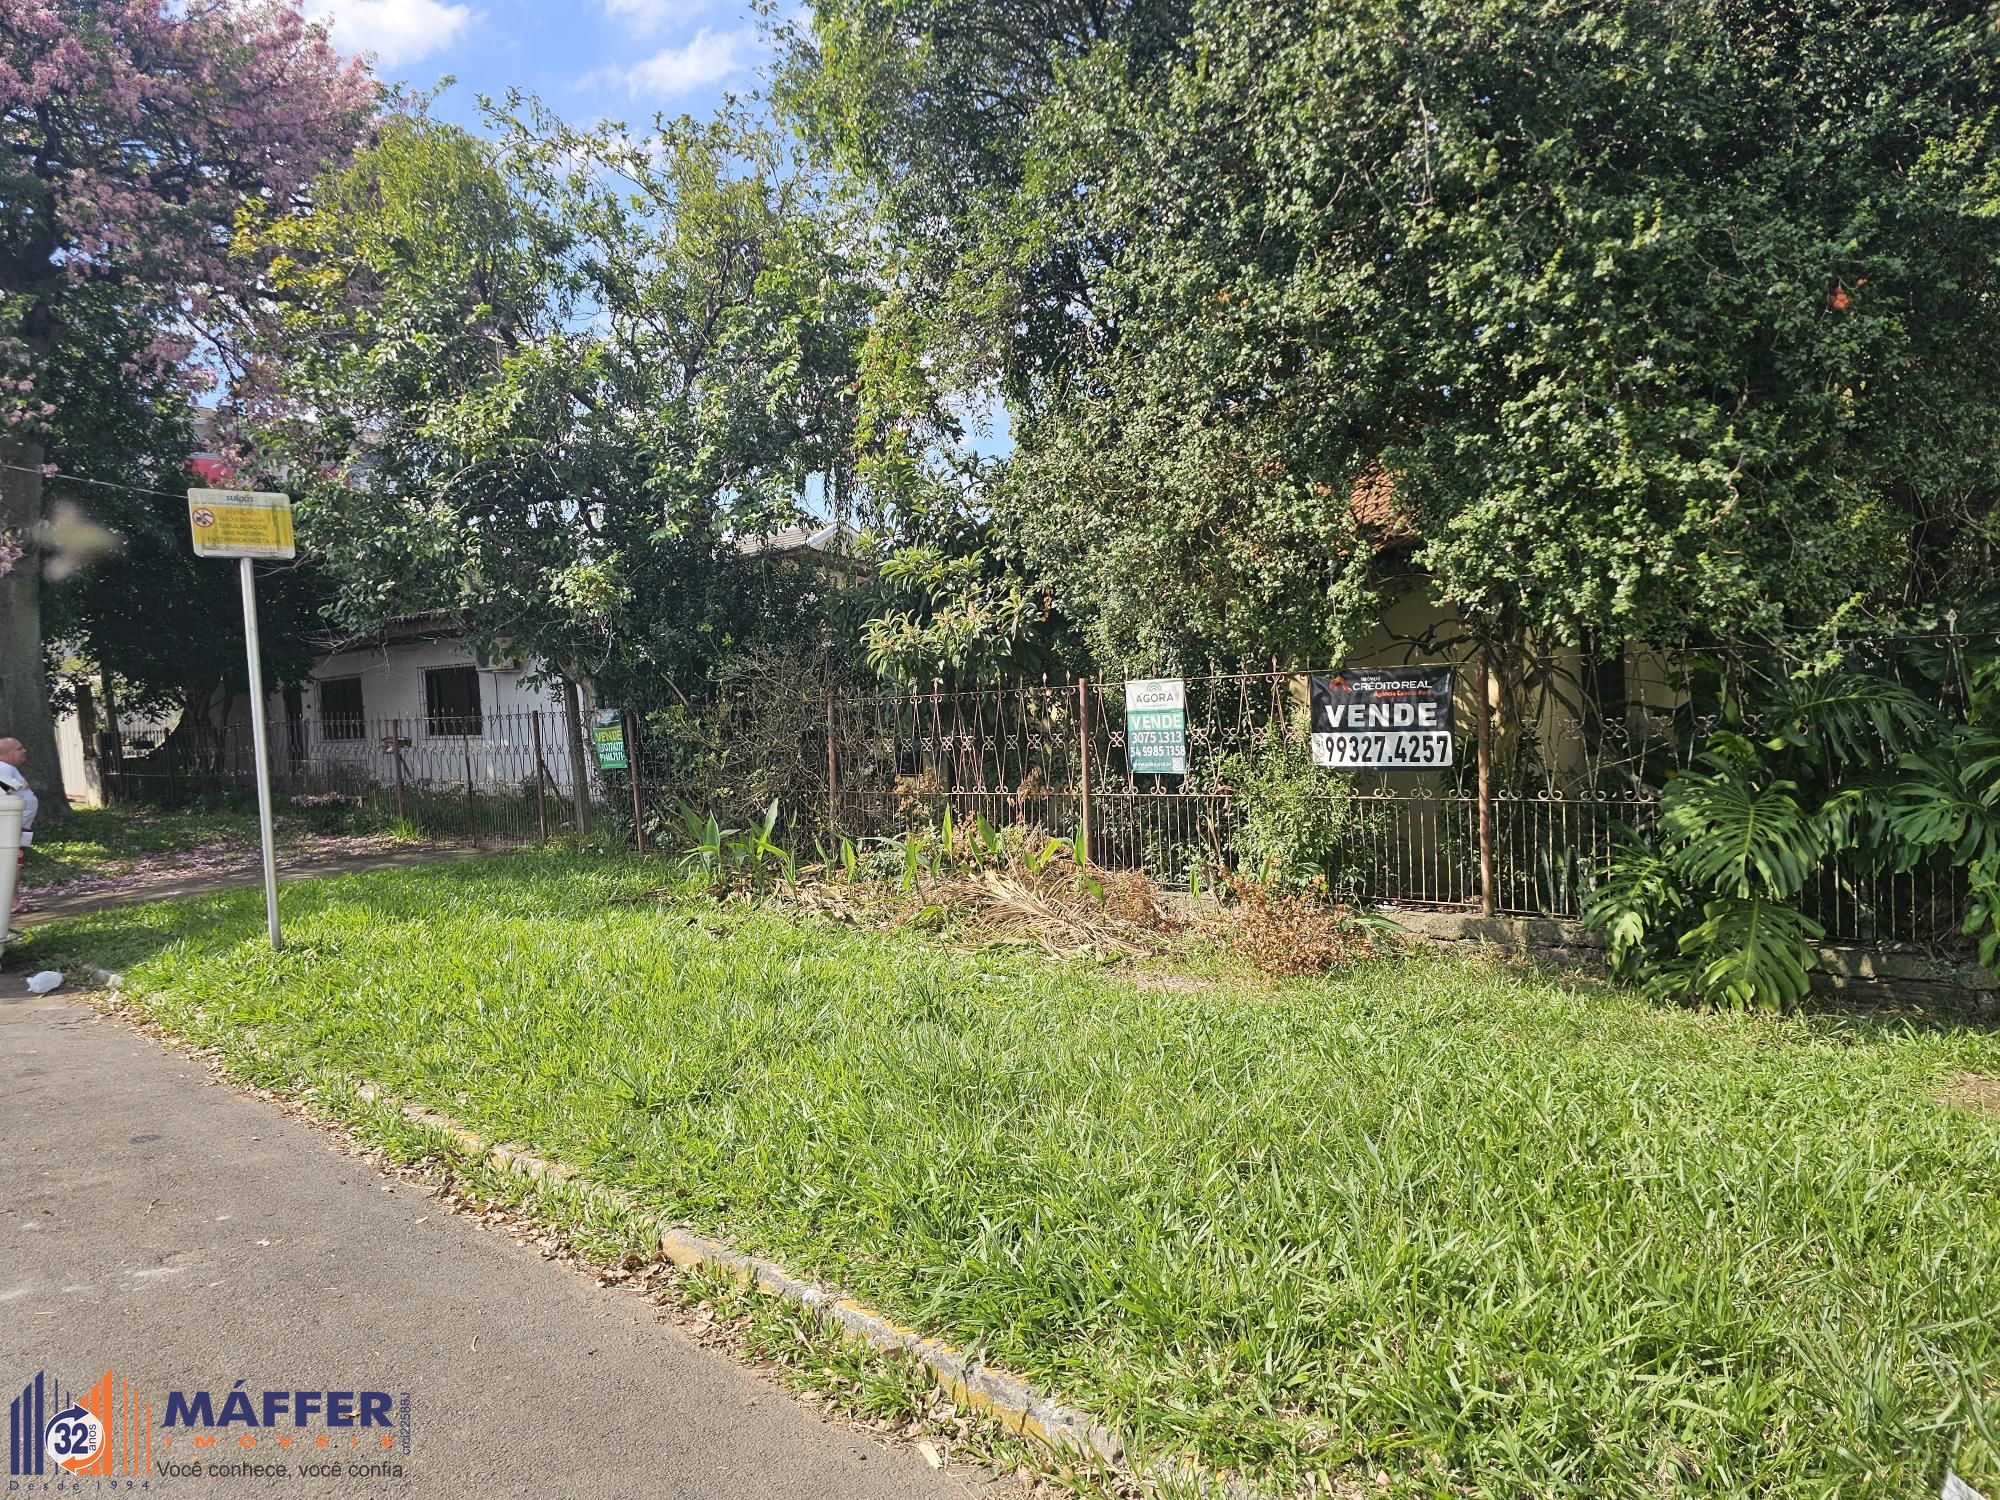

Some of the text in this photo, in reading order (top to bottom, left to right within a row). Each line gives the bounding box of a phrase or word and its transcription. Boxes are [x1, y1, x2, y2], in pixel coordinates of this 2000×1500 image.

[1401, 680, 1433, 690] REAL
[1131, 714, 1183, 730] VENDE
[1325, 702, 1438, 728] VENDE
[595, 730, 623, 742] VENDE
[1131, 731, 1183, 744] 3075 1313
[1325, 735, 1449, 763] 99327.4257
